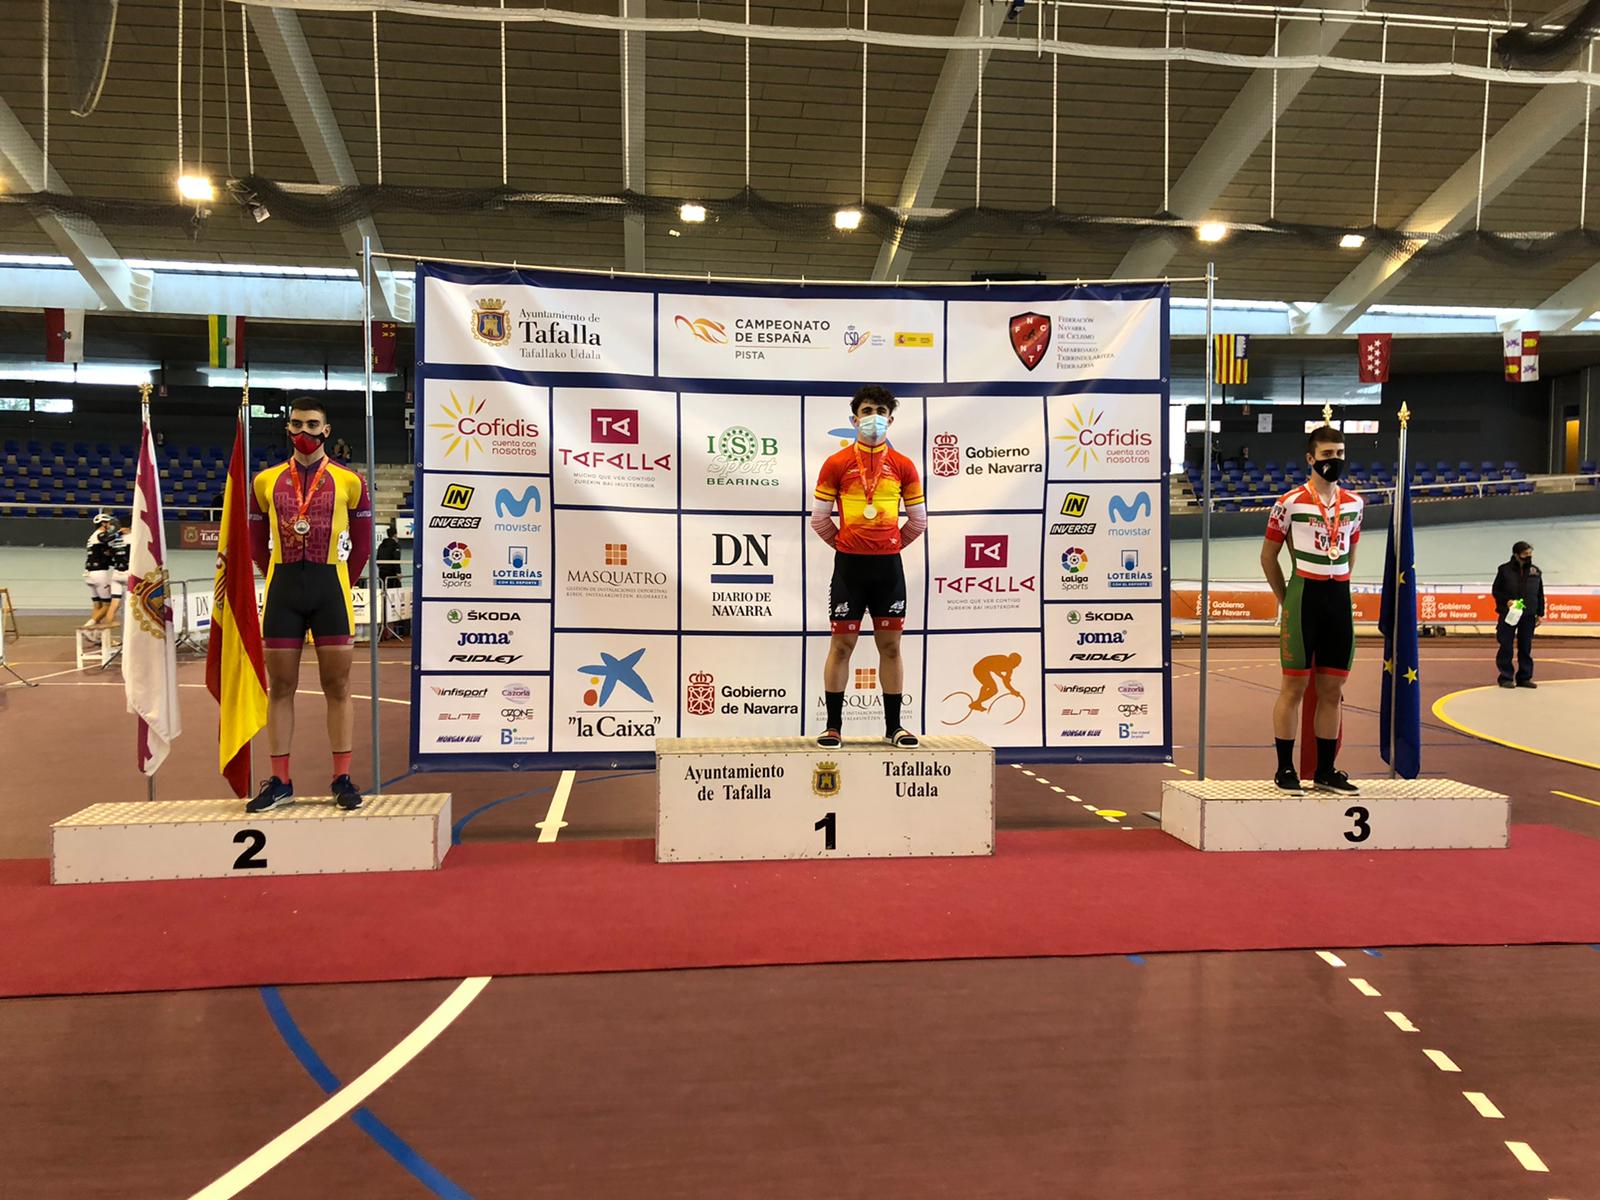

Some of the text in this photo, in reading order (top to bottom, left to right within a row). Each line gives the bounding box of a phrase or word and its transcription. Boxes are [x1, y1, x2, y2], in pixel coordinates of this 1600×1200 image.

[518, 308, 600, 323] Ayuntamiento de
[735, 318, 830, 331] CAMPEONATO
[518, 321, 601, 346] Tafalla
[735, 331, 811, 344] DE ESPAÑA
[519, 348, 601, 360] Tafallako Udala
[735, 350, 765, 360] PISTA
[458, 417, 539, 437] Cofidis
[597, 416, 630, 436] TA
[1079, 428, 1152, 446] Cofidis
[492, 447, 536, 455] nosotros
[965, 446, 1030, 459] Gobierno
[559, 448, 671, 471] TAFALLA
[1106, 455, 1149, 463] nosotros
[707, 455, 777, 478] Sport
[966, 463, 1043, 475] de Navarra
[707, 478, 779, 486] BEARINGS
[447, 489, 469, 504] IN
[1065, 498, 1085, 512] IN
[430, 517, 480, 528] INVERSE
[494, 523, 542, 532] movistar
[1050, 524, 1095, 535] INVERSE
[1108, 528, 1151, 536] movistar
[712, 533, 772, 567] DN
[970, 543, 1001, 561] TA
[442, 571, 472, 580] LaLiga
[493, 569, 542, 578] LOTERÍAS
[567, 570, 667, 586] MASQUATRO
[1062, 575, 1088, 583] LaLiga
[1107, 571, 1153, 580] LOTERÍAS
[442, 579, 472, 588] Sports
[934, 576, 1035, 593] TAFALLA
[1062, 582, 1088, 591] Sports
[712, 592, 771, 602] DIARIO DE
[196, 596, 209, 616] DN
[712, 605, 772, 616] NAVARRA
[1212, 601, 1245, 609] Gobierno
[467, 610, 521, 621] ŠKODA
[1085, 611, 1134, 621] ŠKODA
[448, 654, 523, 664] RIDLEY
[1069, 653, 1136, 662] RIDLEY
[441, 688, 488, 698] infisport
[721, 686, 786, 698] Gobierno
[1063, 685, 1105, 694] infisport
[817, 694, 913, 709] MSQUAO
[721, 703, 798, 714] de Navarra
[501, 728, 513, 745] B
[1060, 729, 1087, 737] MORGAN
[1119, 723, 1130, 739] B
[436, 735, 483, 743] MORGAN BLUE
[684, 763, 784, 784] Ayuntamiento
[882, 761, 951, 777] Tafallako
[697, 784, 771, 801] de Tafalla
[895, 781, 938, 798] Udala
[1343, 806, 1371, 842] 3
[814, 812, 836, 850] 1
[232, 829, 268, 870] 2
